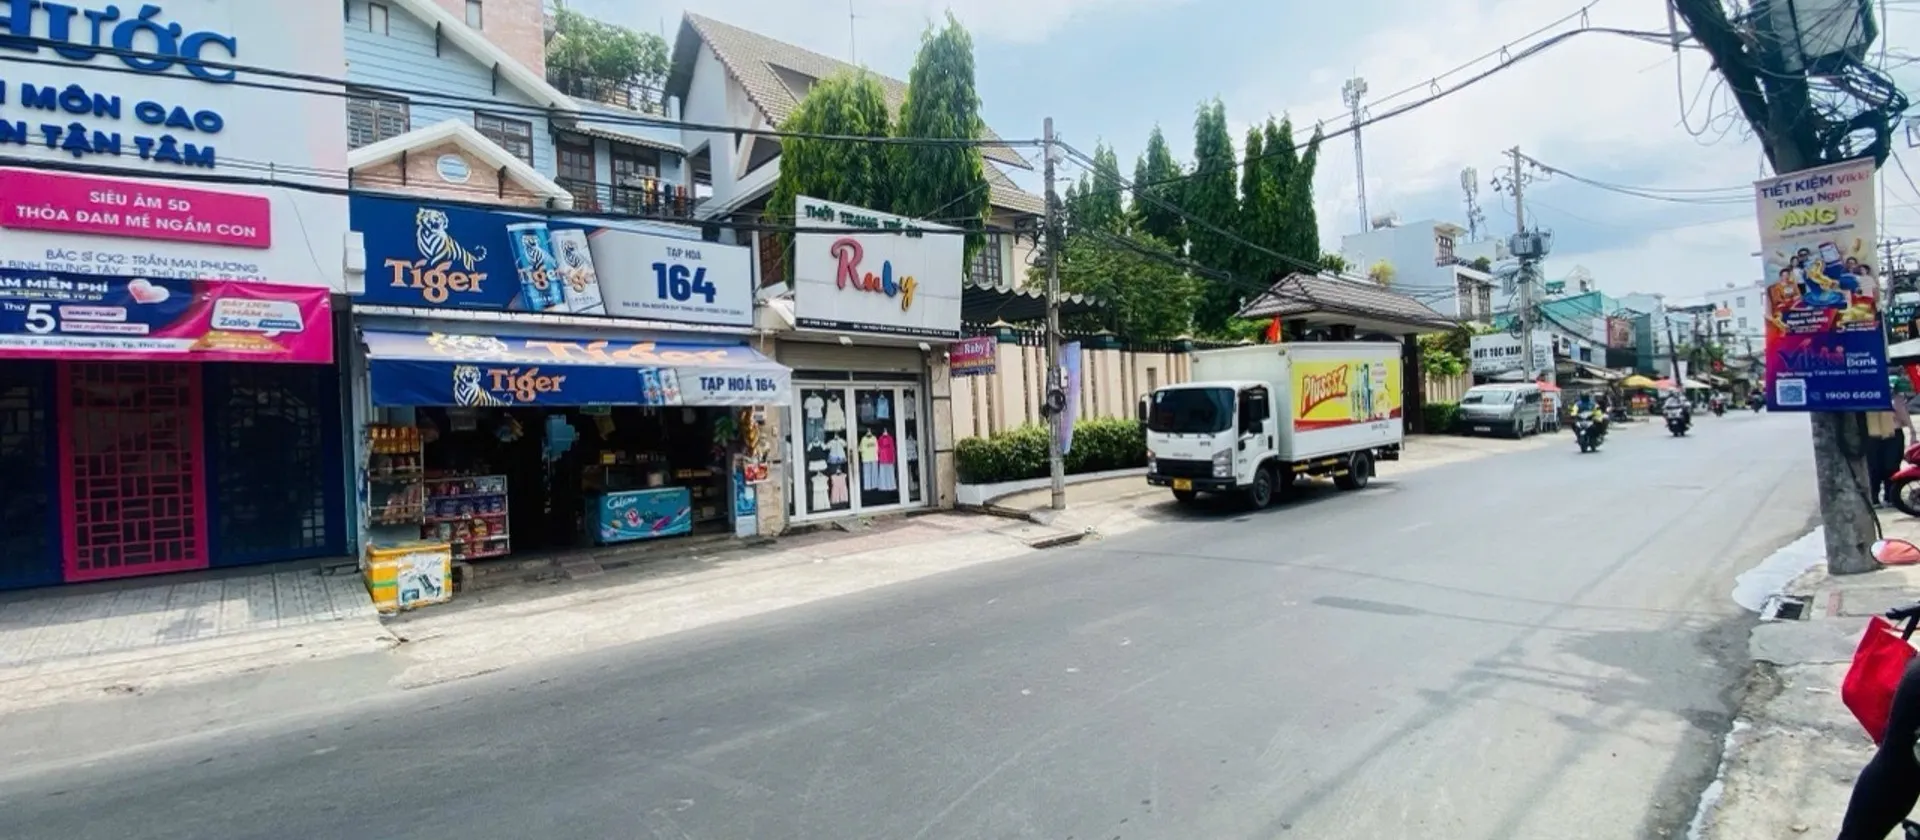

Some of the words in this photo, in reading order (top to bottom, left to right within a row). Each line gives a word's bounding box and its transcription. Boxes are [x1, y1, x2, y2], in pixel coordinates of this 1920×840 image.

[21, 83, 121, 119] MÔN
[40, 122, 121, 158] TẬN
[133, 134, 216, 169] TÂM
[1760, 179, 1793, 199] TIẾT
[1795, 174, 1834, 193] KIỆM
[90, 190, 127, 206] SIÊU
[133, 193, 162, 209] ÂM
[168, 199, 191, 212] 5D
[1777, 196, 1814, 210] Trúng
[16, 203, 70, 221] THỎA
[76, 209, 119, 226] ĐAM
[156, 216, 212, 234] NGẮM
[216, 223, 257, 238] CON
[1774, 208, 1838, 231] VÀNG
[46, 248, 77, 261] BÁC
[171, 259, 198, 269] MAI
[200, 259, 259, 274] PHƯƠNG
[26, 277, 73, 290] MIỄN
[78, 281, 108, 293] PHÍ
[384, 258, 488, 304] Tiger
[652, 262, 717, 304] 164
[829, 237, 919, 313] Ruby
[4, 303, 26, 311] Thứ
[25, 303, 56, 334] 5
[220, 316, 250, 327] Zalo
[964, 341, 985, 356] Ruby
[1846, 357, 1878, 368] Bank
[487, 367, 566, 402] Tiger
[699, 376, 725, 395] TẠP
[728, 374, 753, 392] HOÁ
[755, 378, 777, 392] 164
[1825, 391, 1851, 400] 1900
[1852, 390, 1882, 400] 6608
